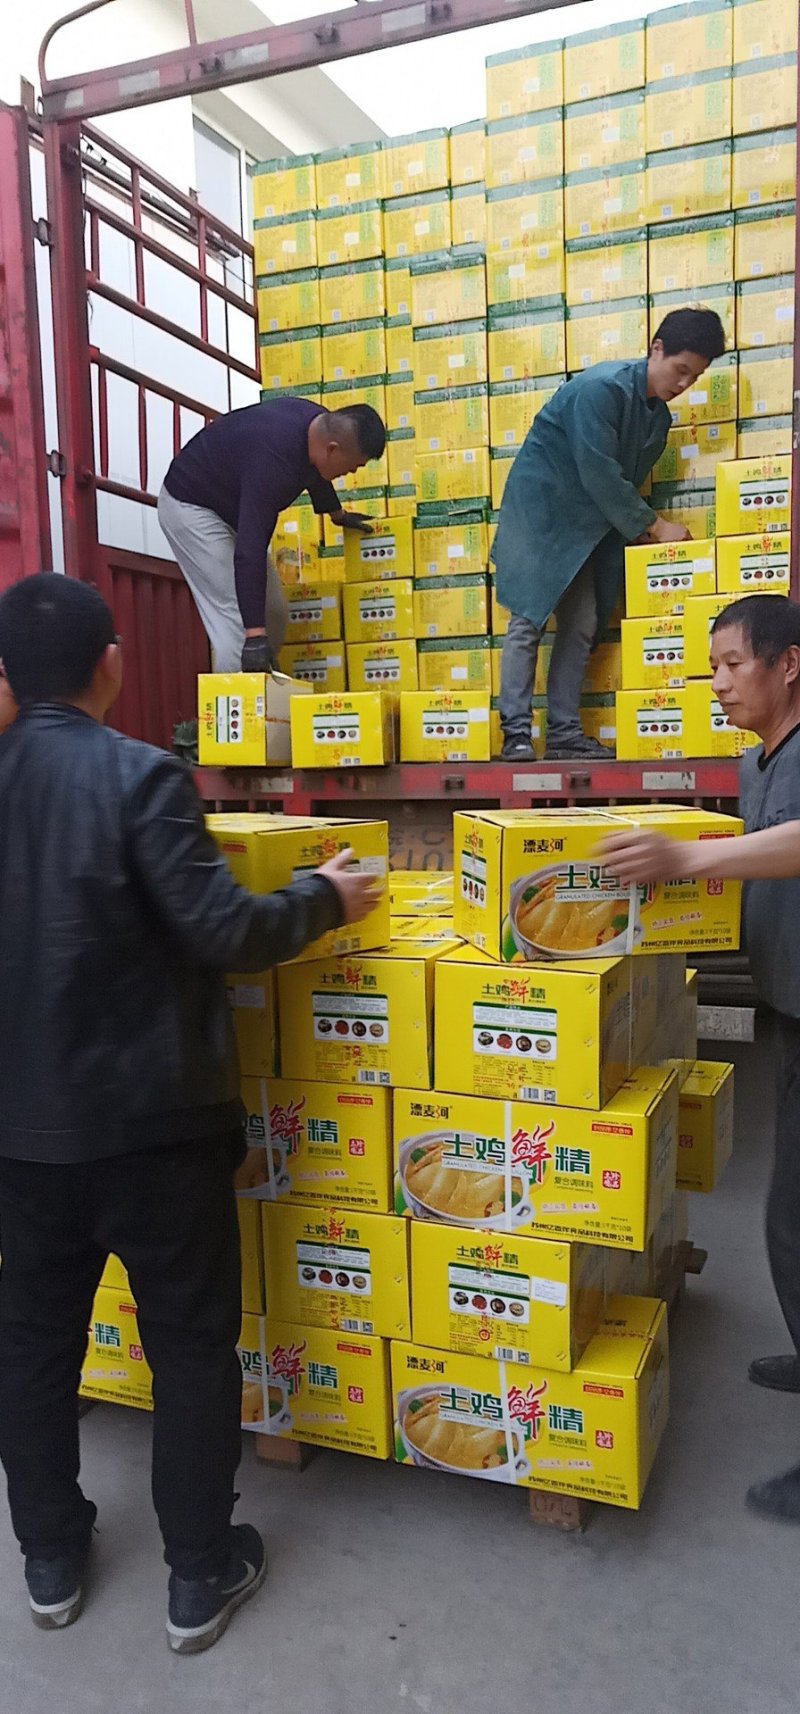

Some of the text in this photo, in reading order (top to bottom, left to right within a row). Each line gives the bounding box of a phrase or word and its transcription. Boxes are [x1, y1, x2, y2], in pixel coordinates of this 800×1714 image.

[442, 1120, 591, 1184] 土鸡鲜精
[439, 1379, 583, 1440] 土鸡鲜精
